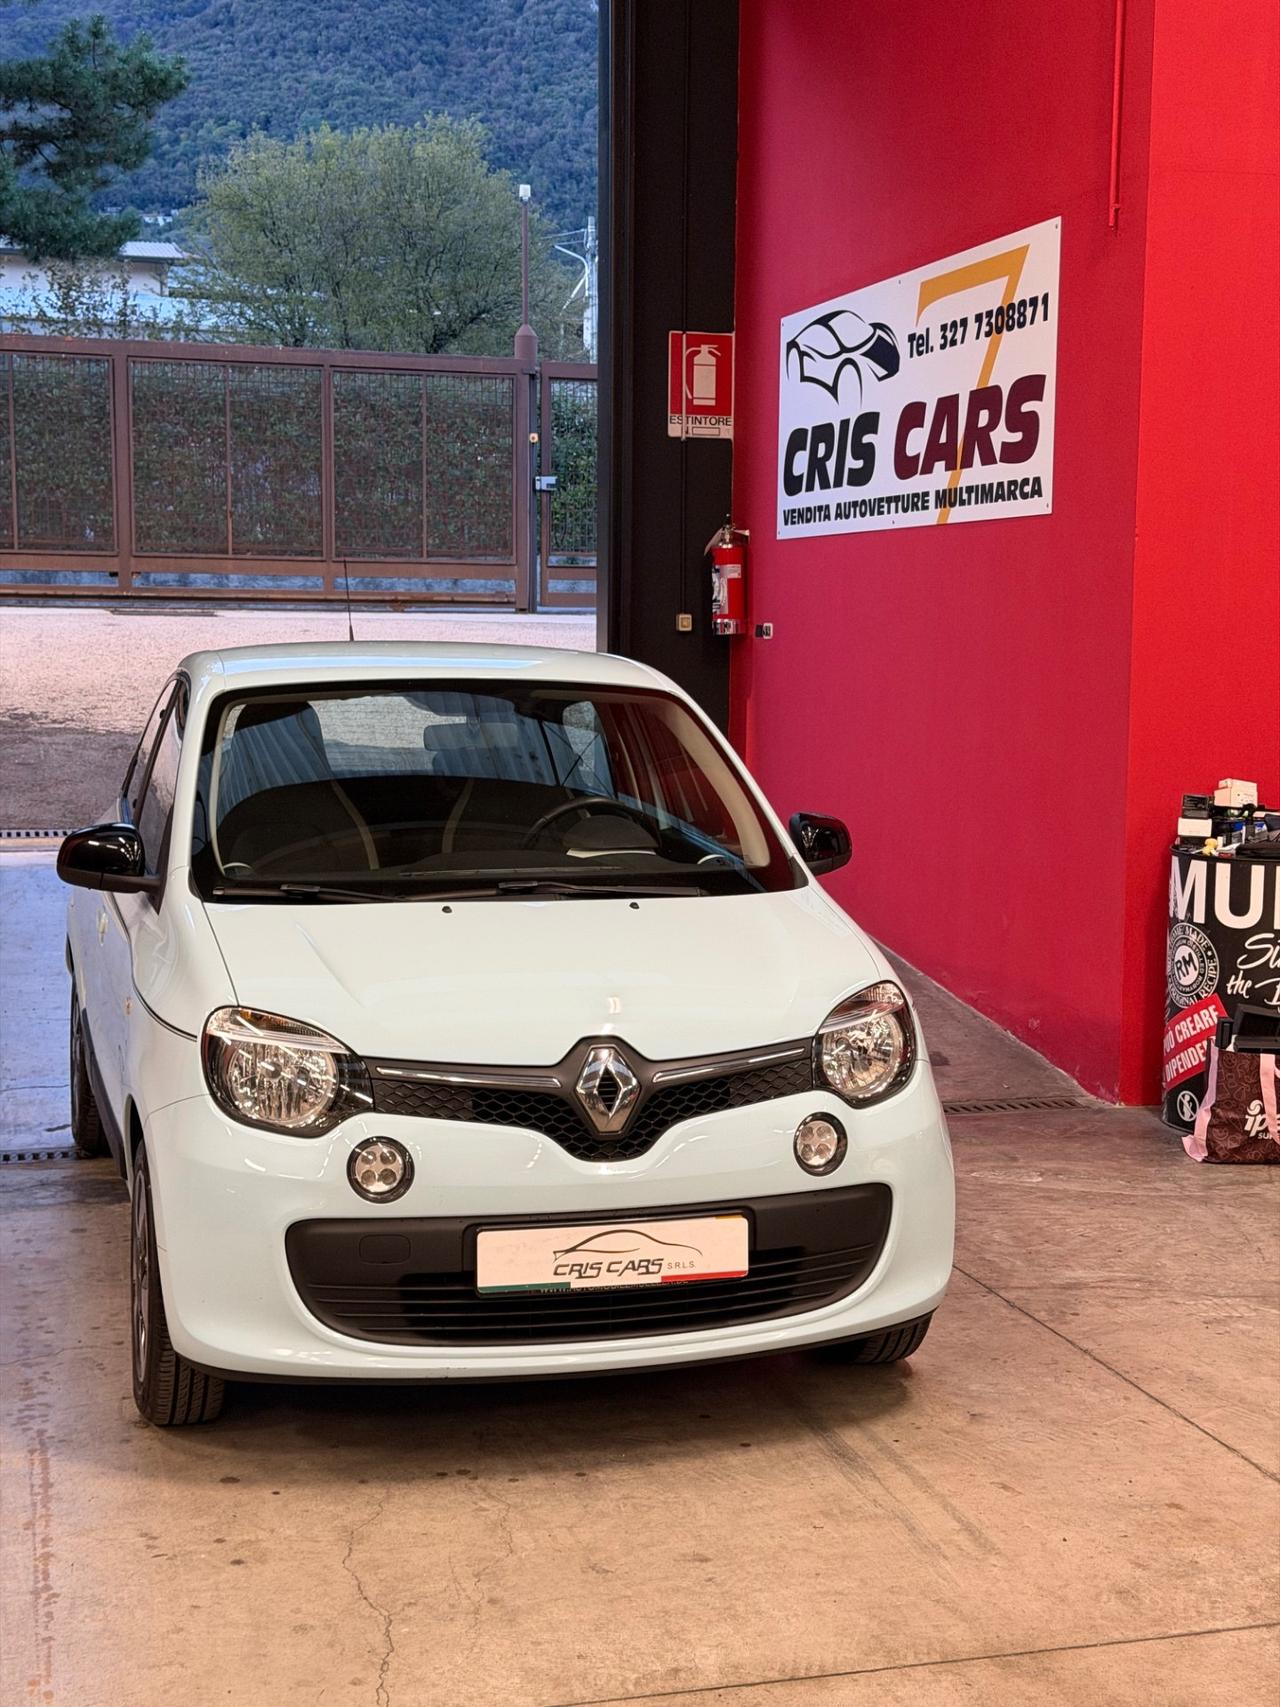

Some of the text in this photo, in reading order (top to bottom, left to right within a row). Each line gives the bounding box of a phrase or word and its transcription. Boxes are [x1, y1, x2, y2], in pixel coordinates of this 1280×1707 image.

[908, 293, 1049, 358] Tel. 327 7308871
[669, 415, 732, 427] ESTINTORE
[783, 374, 1047, 497] CRIS CARS
[783, 476, 1043, 527] VENDITA AUTOVETTURE MULTIMARCA
[1169, 855, 1280, 930] MU
[1175, 951, 1198, 980] RM
[1237, 932, 1280, 969] Si
[1199, 957, 1217, 999] RECIPE
[1226, 970, 1252, 998] the
[553, 1261, 603, 1280] CRIS
[606, 1258, 664, 1275] CARS
